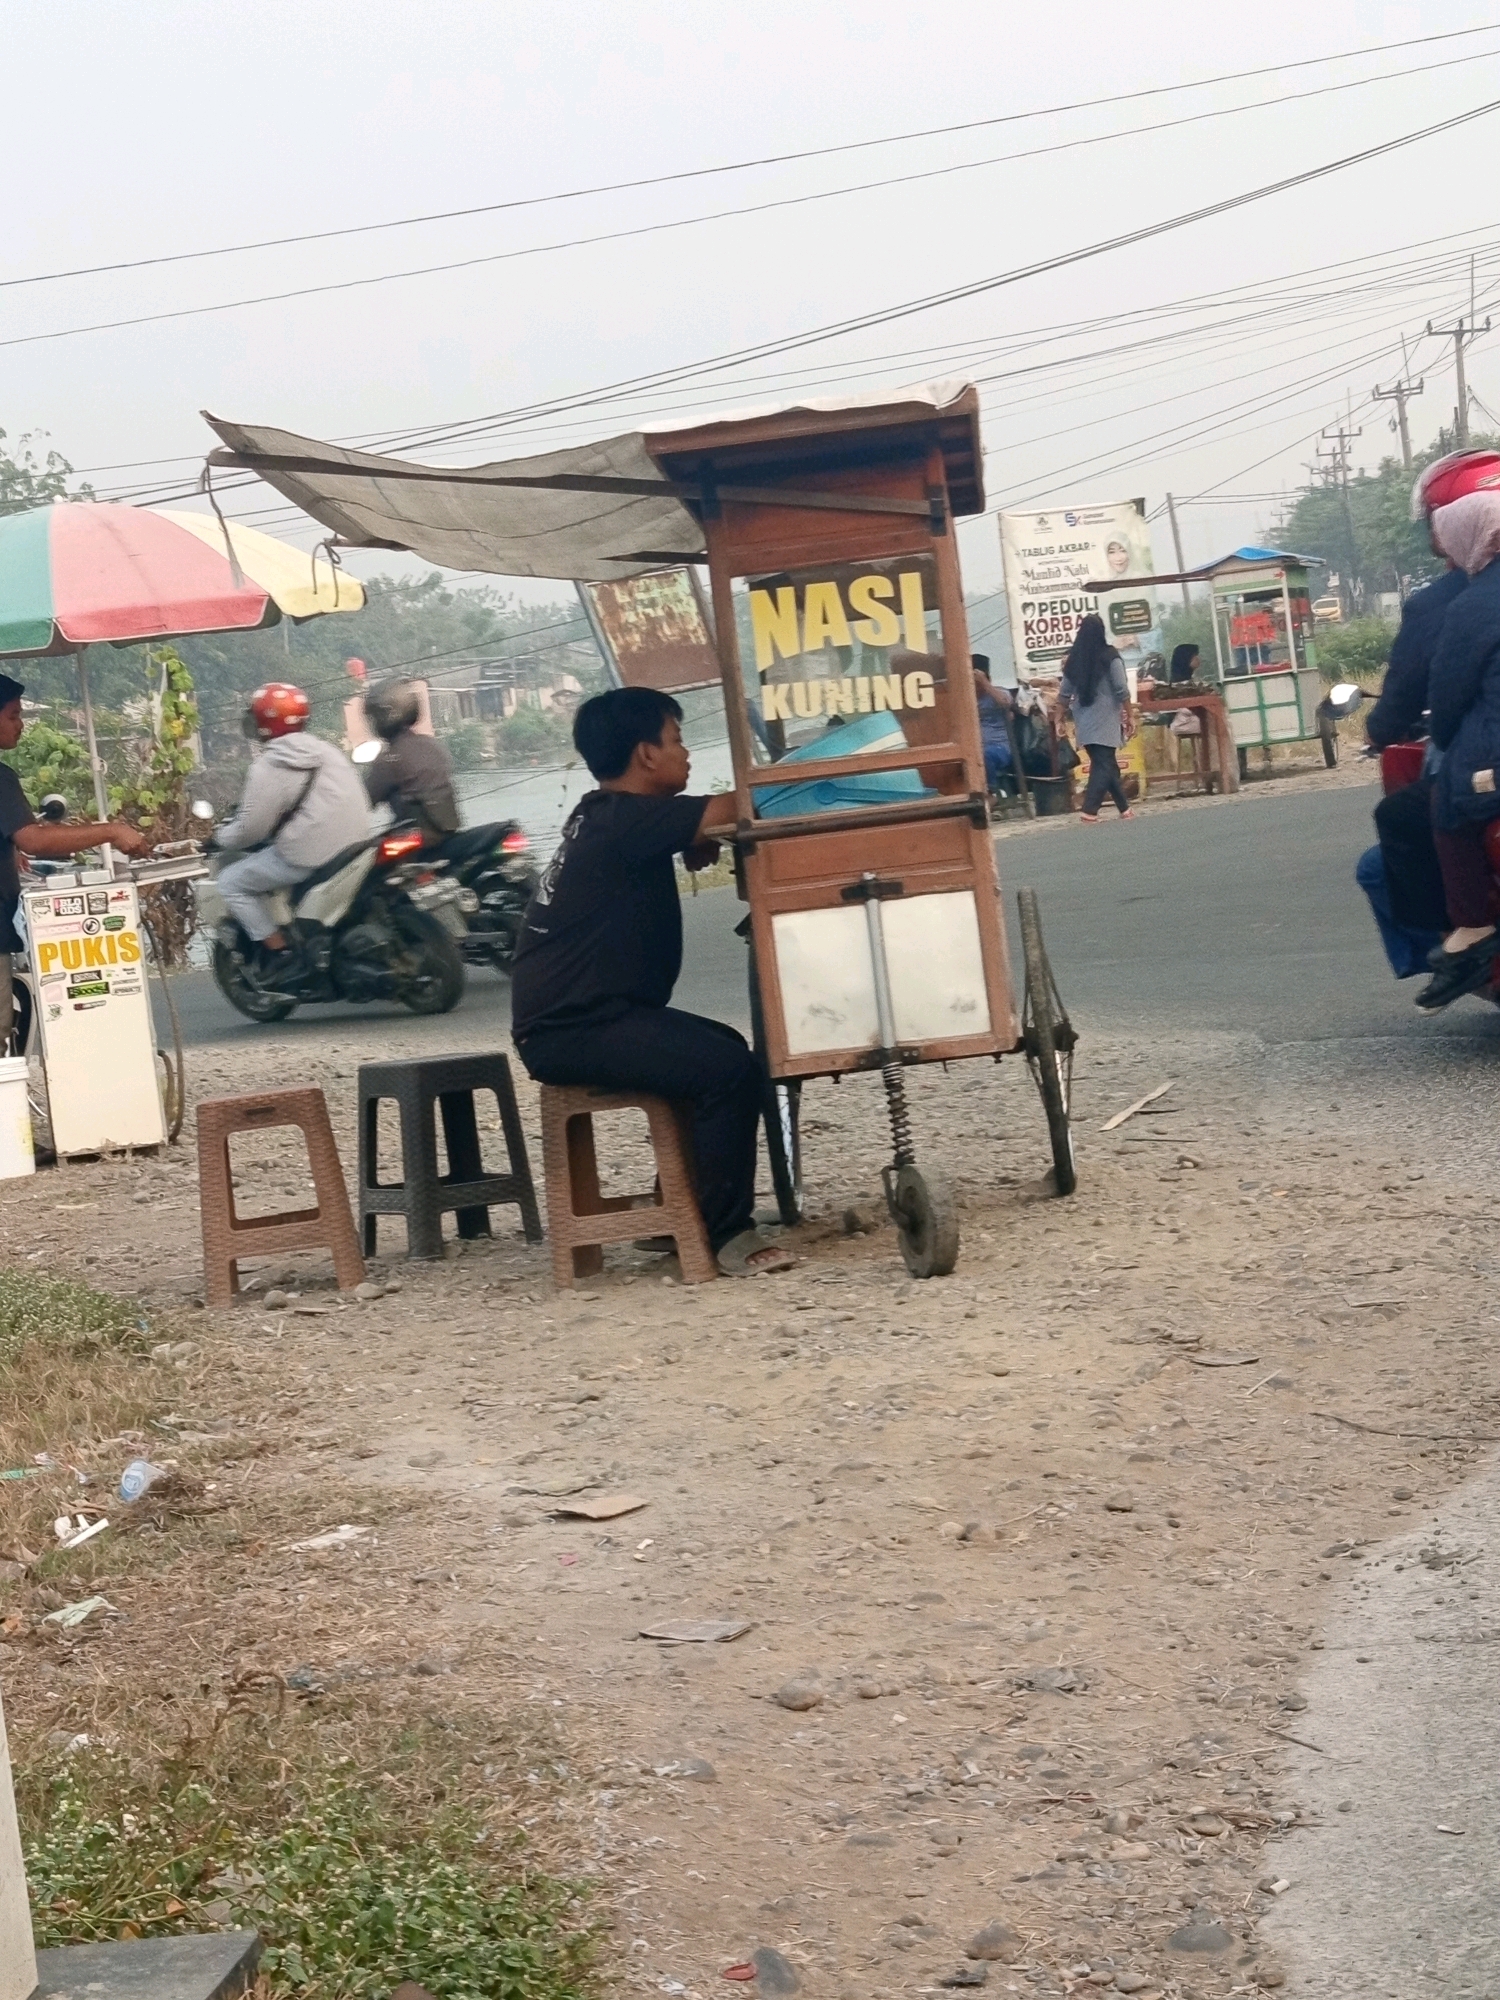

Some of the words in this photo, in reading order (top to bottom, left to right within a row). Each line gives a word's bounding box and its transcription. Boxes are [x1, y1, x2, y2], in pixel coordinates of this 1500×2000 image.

[1021, 546, 1055, 558] TABLIG
[1058, 542, 1090, 554] AKBAR
[1038, 596, 1099, 617] PEDULI
[750, 572, 928, 672] NASI
[1024, 613, 1091, 636] KORBA
[1025, 632, 1073, 649] GEMPA
[761, 671, 936, 721] KUNING
[38, 932, 141, 973] PUKIS
